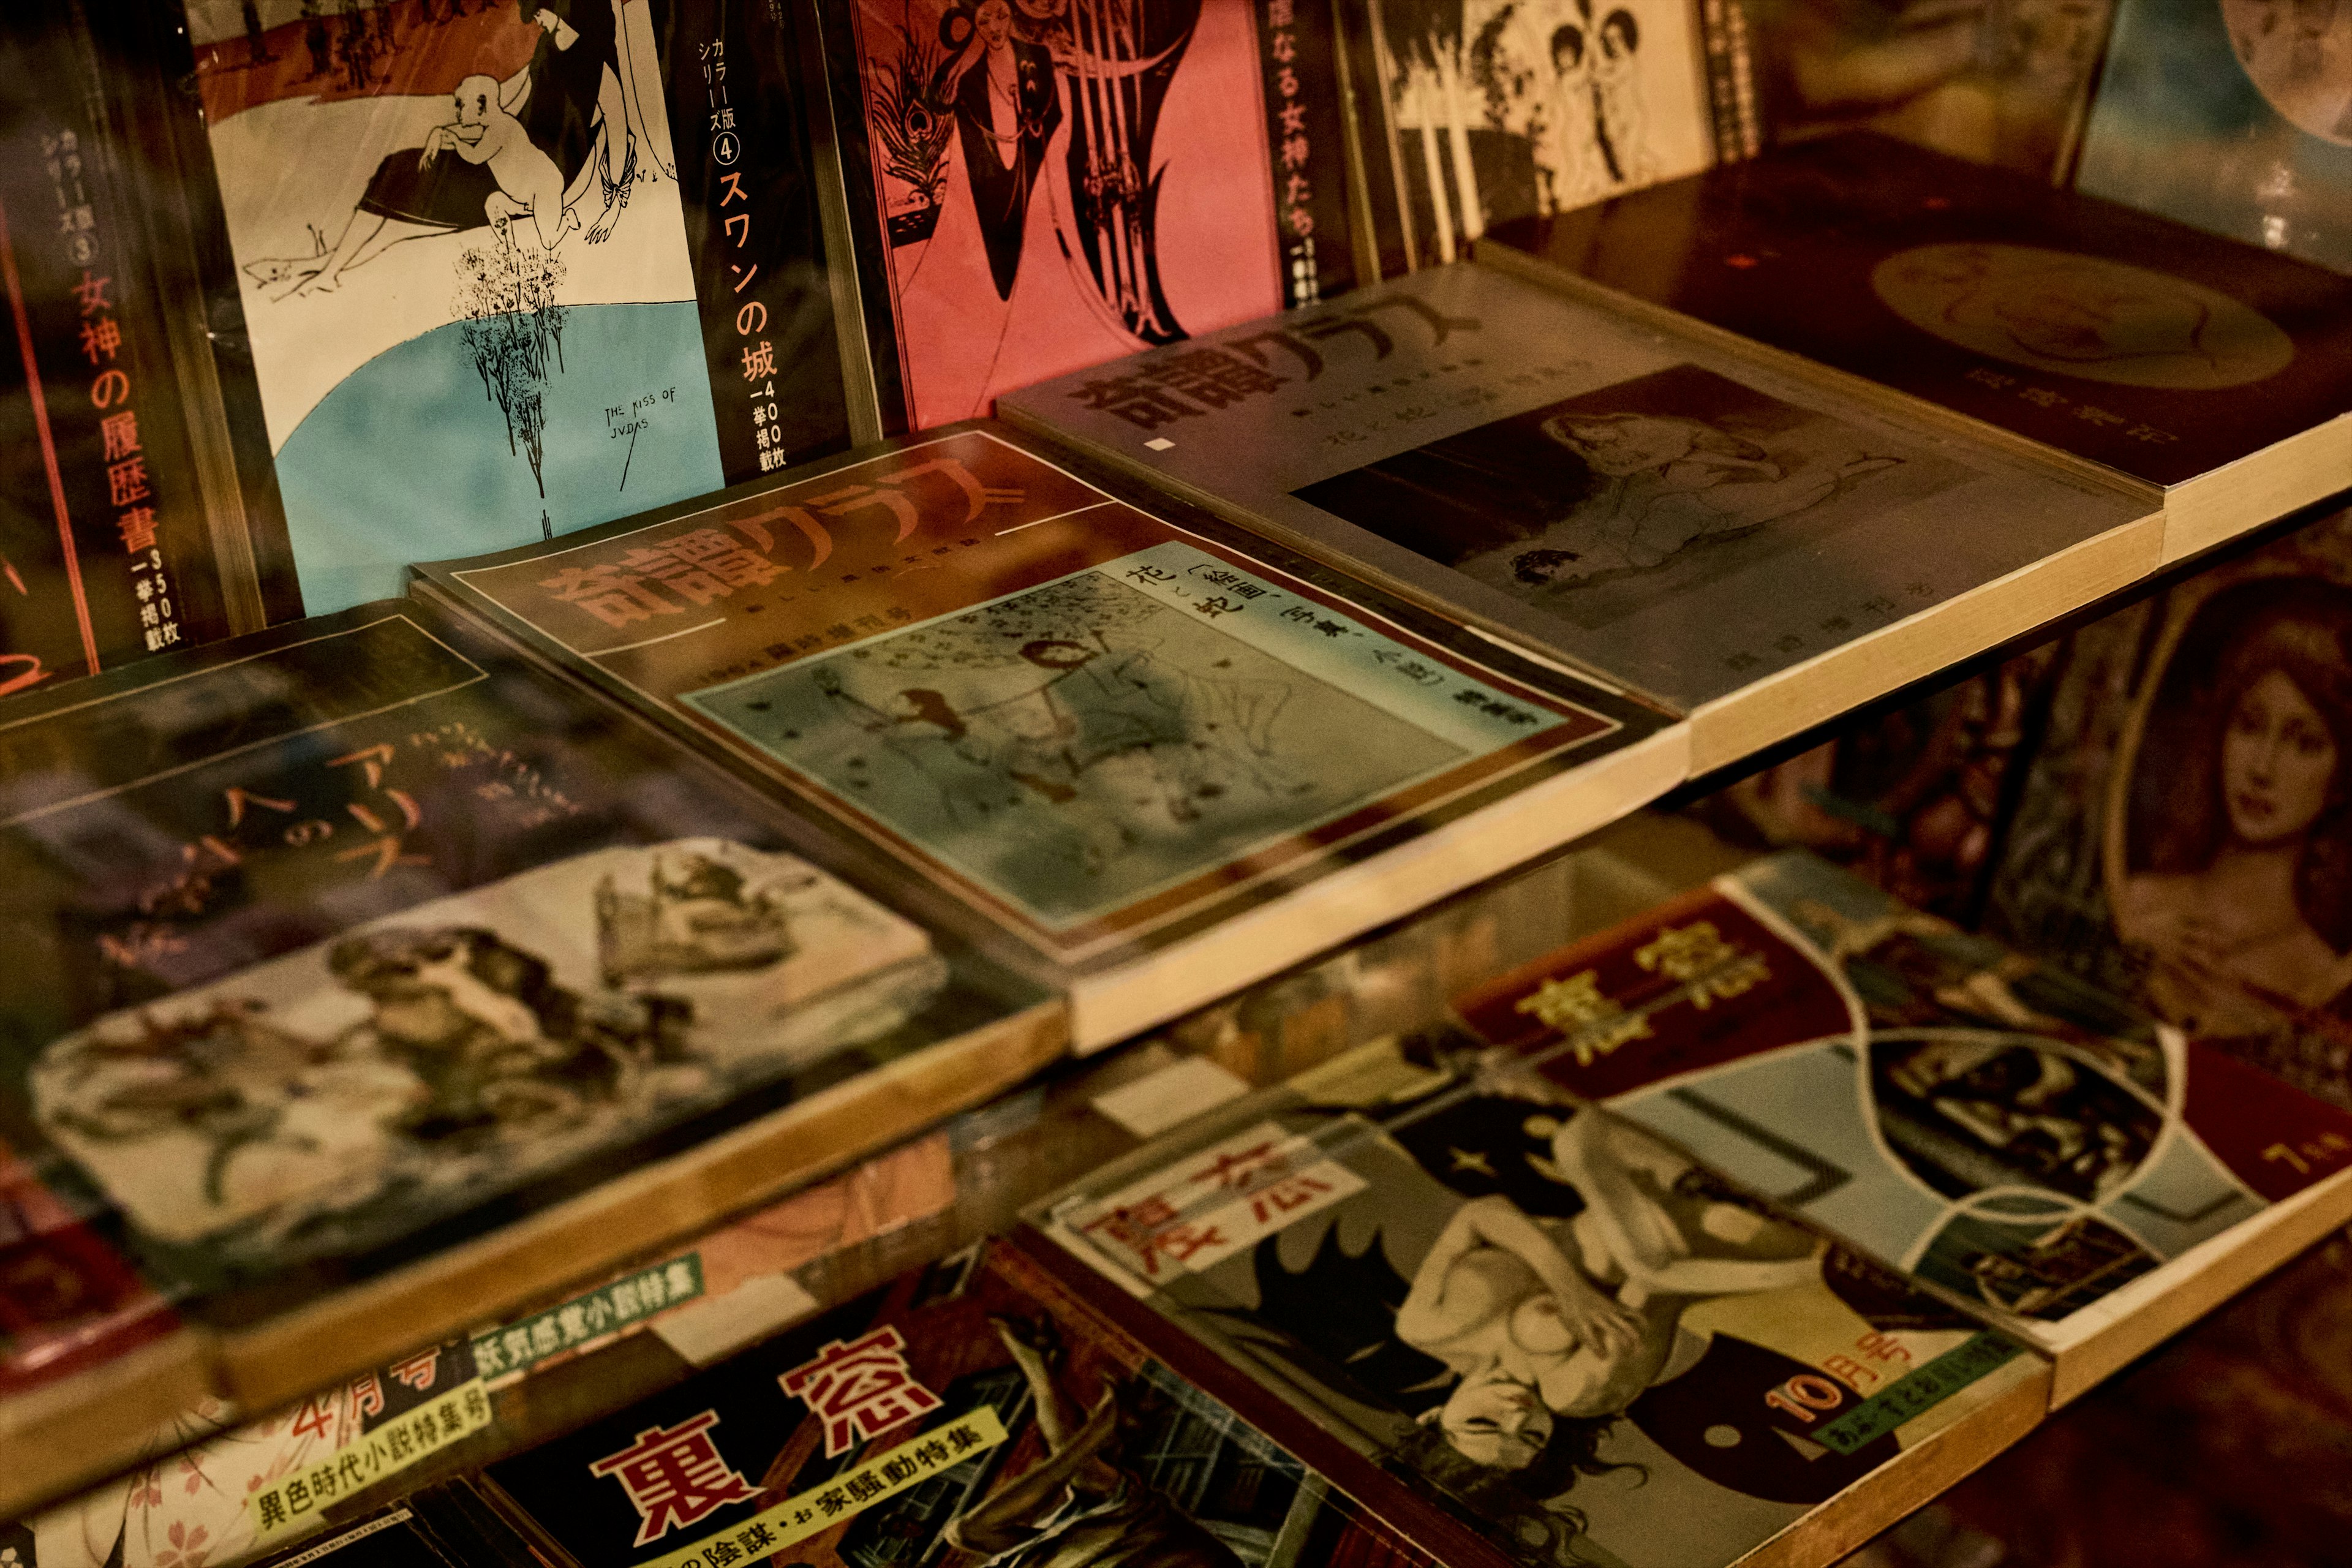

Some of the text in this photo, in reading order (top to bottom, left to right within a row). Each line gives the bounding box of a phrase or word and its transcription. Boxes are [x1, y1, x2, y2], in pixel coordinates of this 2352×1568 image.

[698, 42, 722, 131] シリーズ
[712, 37, 736, 129] カラー版
[719, 172, 778, 383] スワンの城
[72, 271, 159, 556] 女神の履歴書
[605, 386, 677, 426] THE KISS OF
[749, 391, 775, 472] 一挙掲載
[764, 381, 787, 467] 400枚
[538, 458, 1026, 628] 奇譚クラブ
[1126, 564, 1245, 620] 花と蛇
[1764, 1330, 1912, 1425] 10月号
[258, 1388, 489, 1531] 異色時代小説特集号
[589, 1324, 945, 1547] 裏窓
[666, 1424, 984, 1568] の陰謀・お家騒動特集
